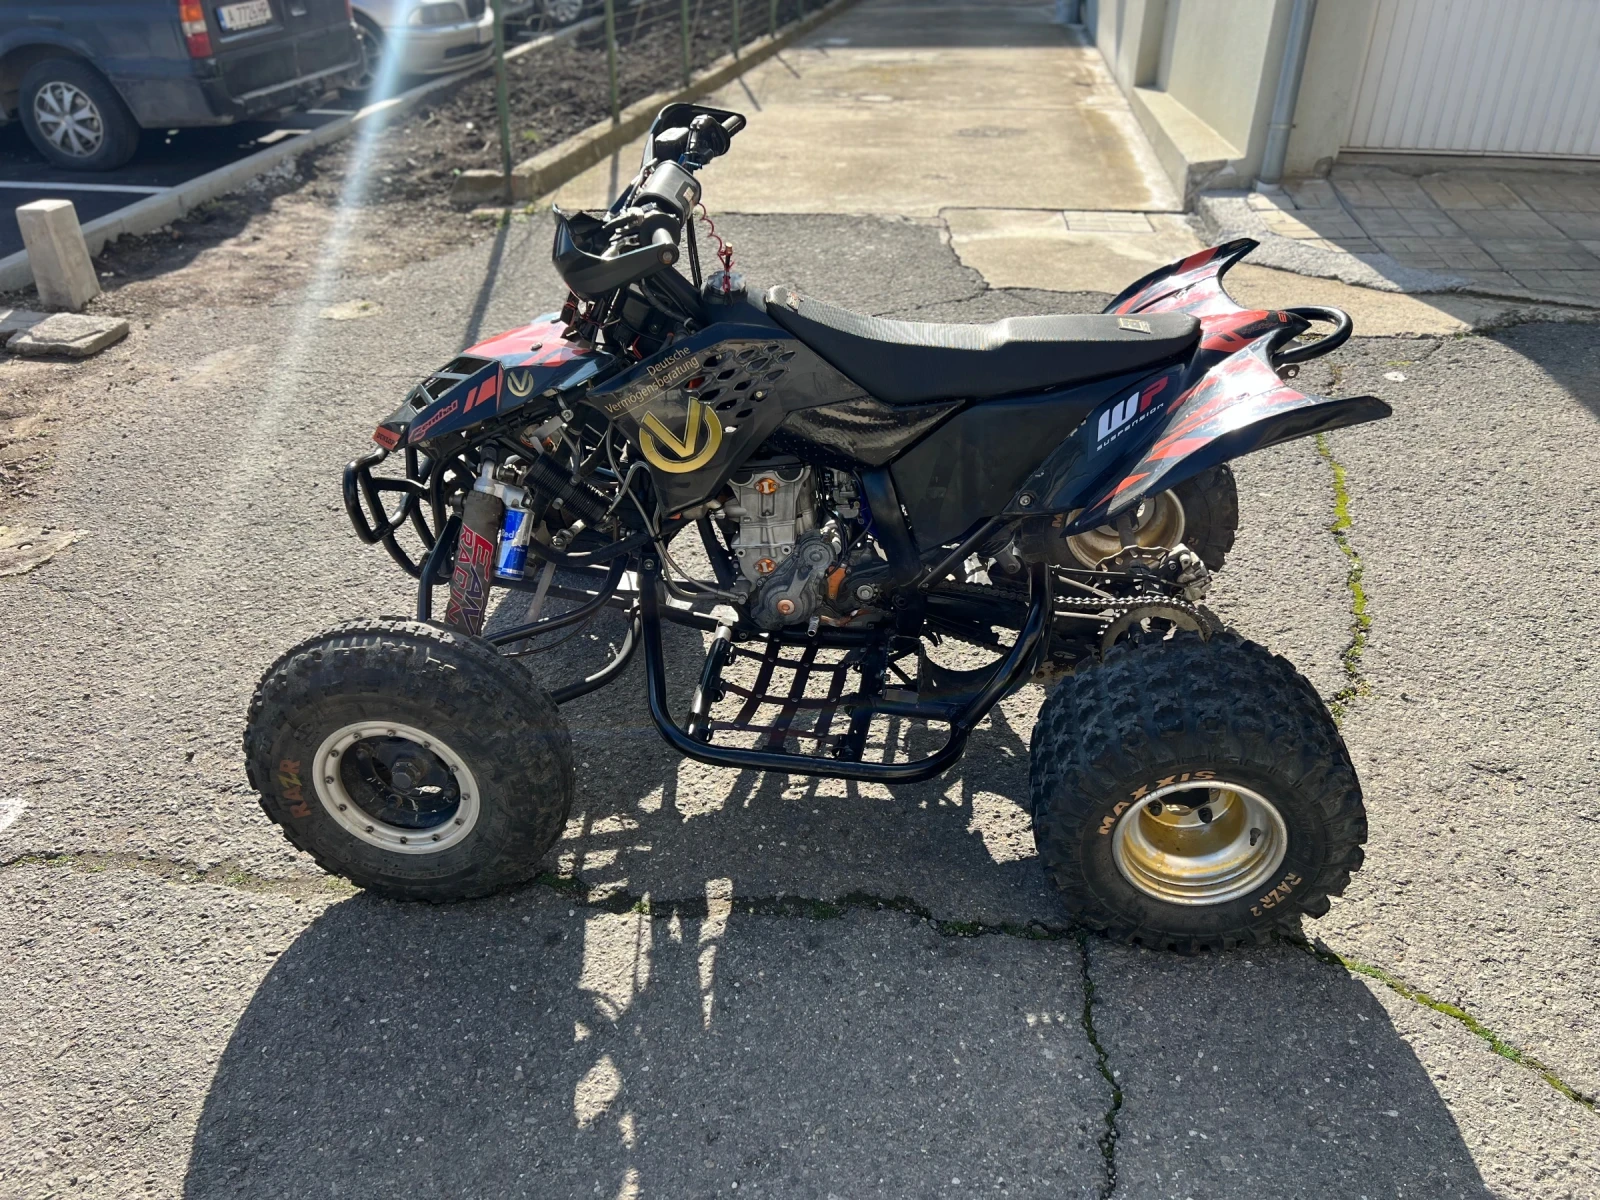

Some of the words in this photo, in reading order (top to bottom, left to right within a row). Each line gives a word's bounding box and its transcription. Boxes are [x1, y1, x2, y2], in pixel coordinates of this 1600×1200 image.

[604, 355, 700, 414] Vermögensberatung
[646, 346, 691, 377] Deutsche
[1097, 376, 1168, 442] WP
[447, 522, 474, 625] RACIN
[1098, 770, 1217, 835] MAXXIS
[1259, 871, 1302, 909] RAZR
